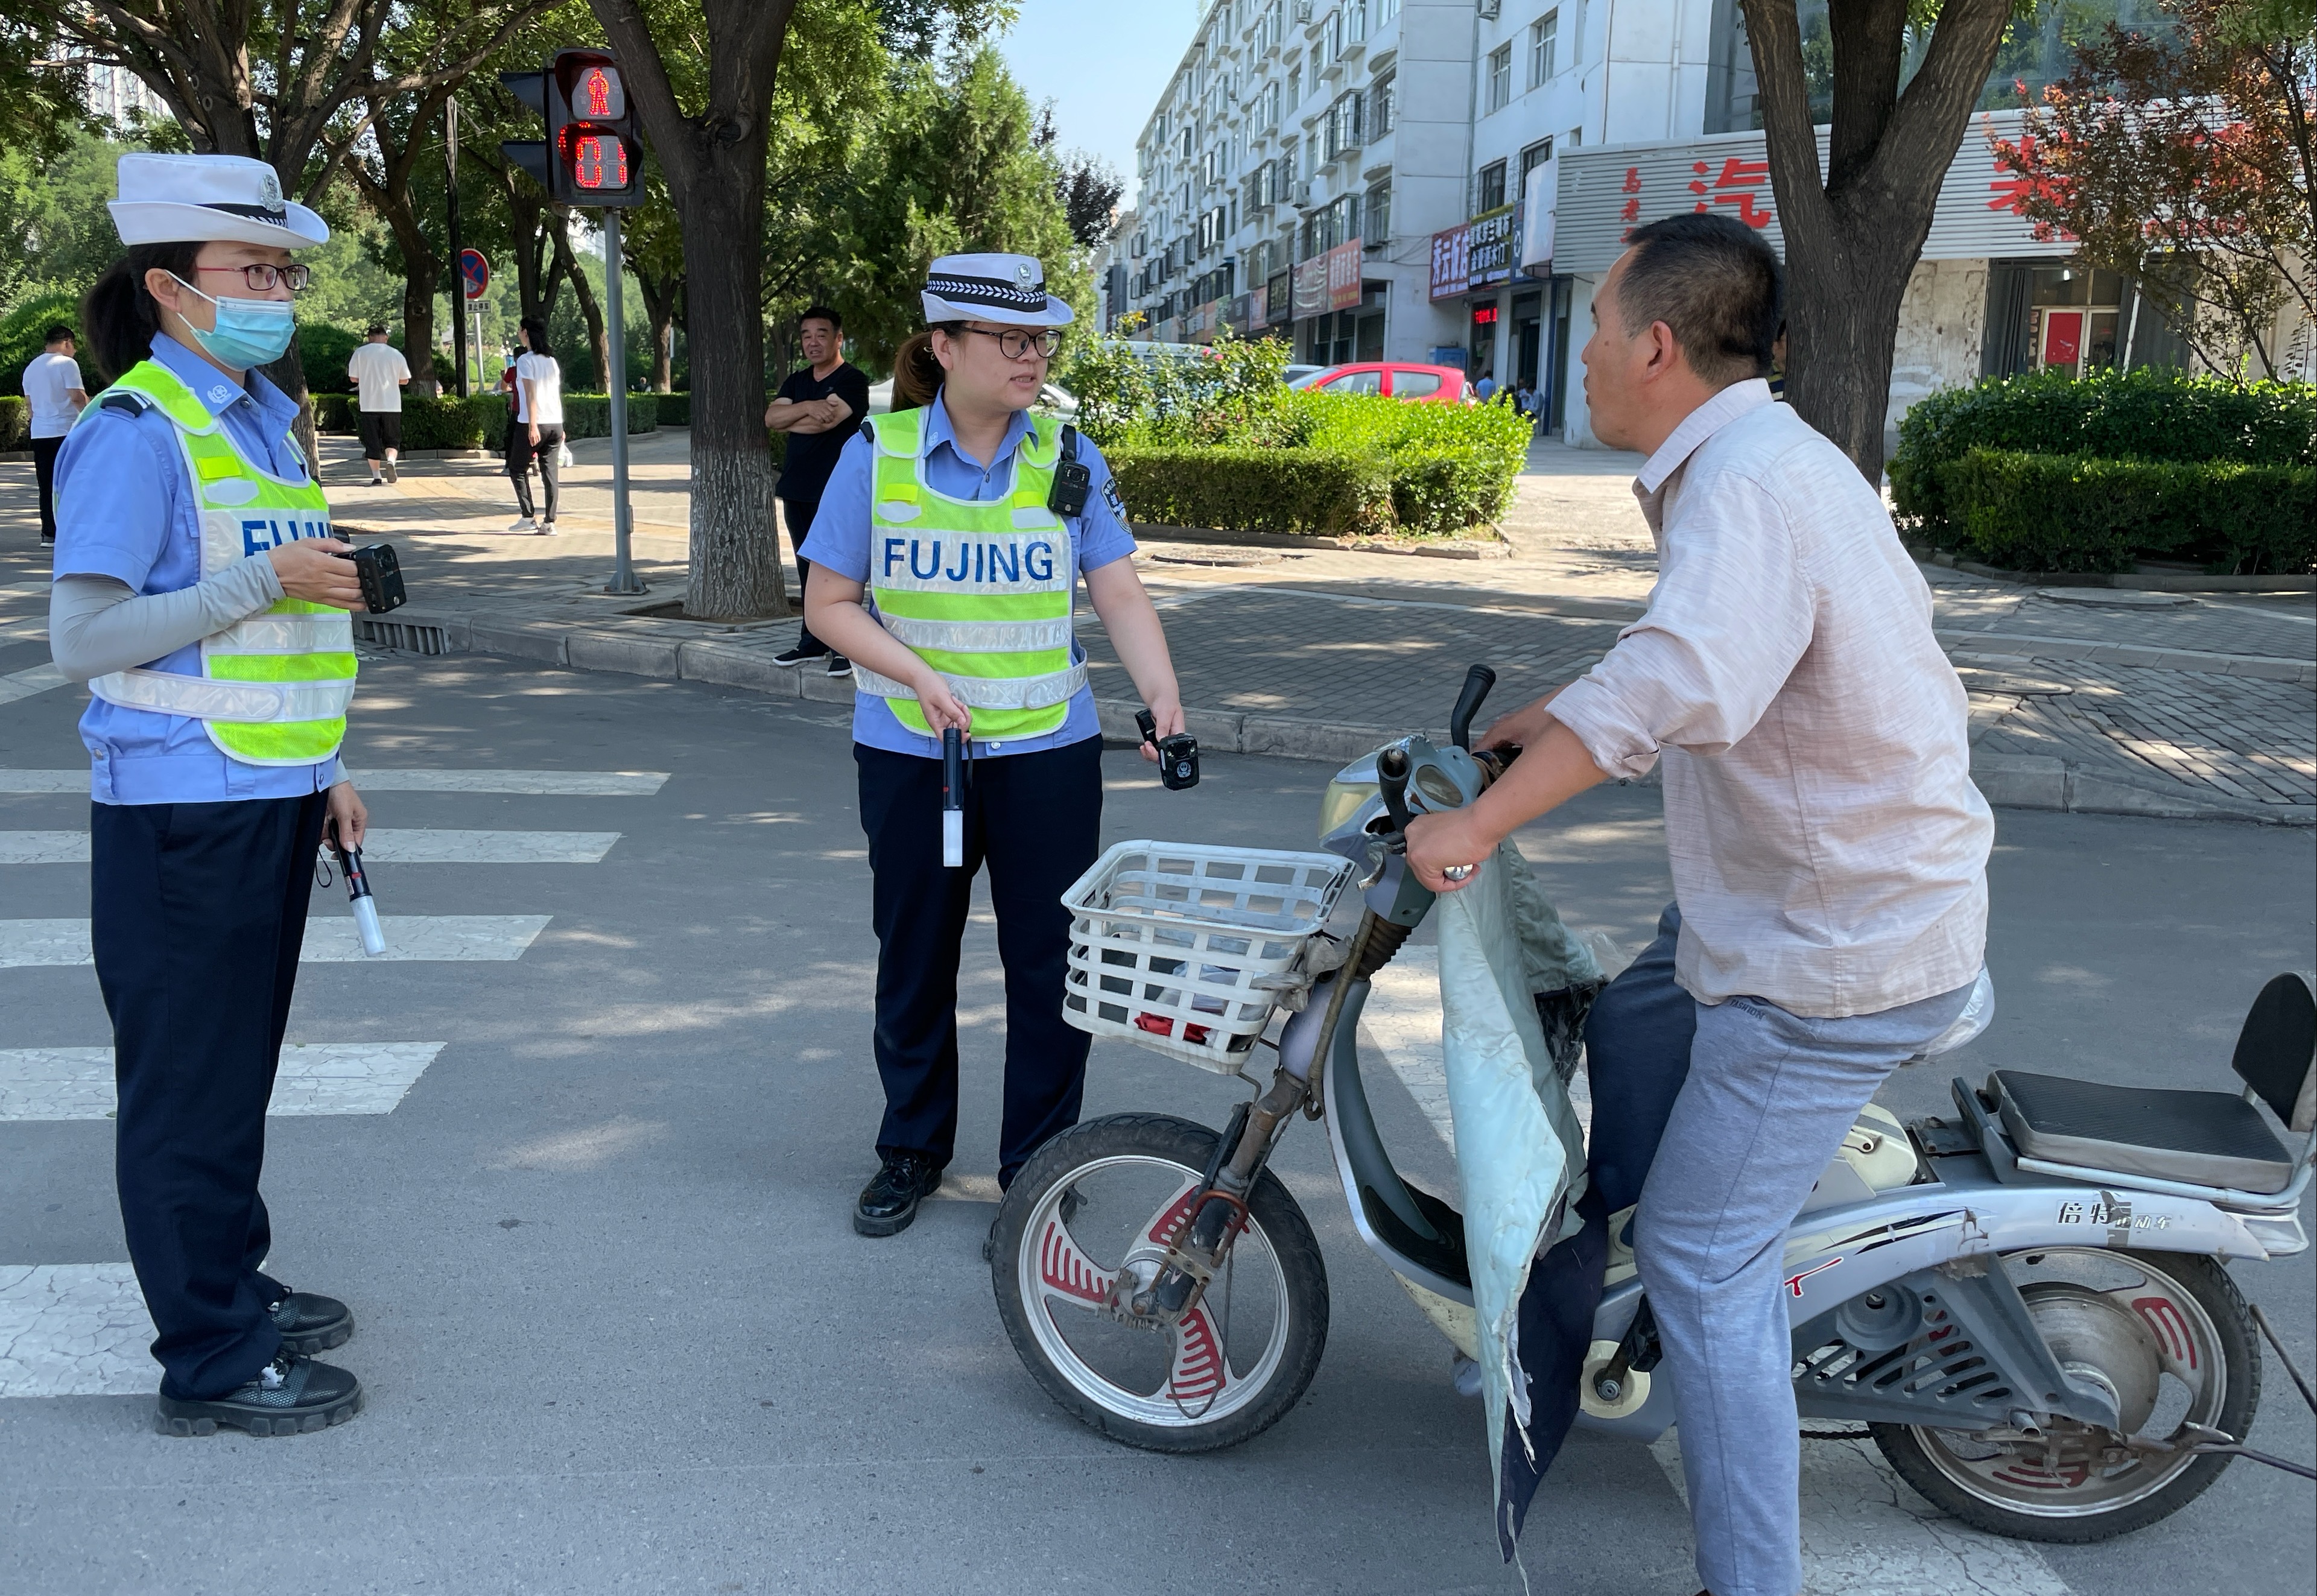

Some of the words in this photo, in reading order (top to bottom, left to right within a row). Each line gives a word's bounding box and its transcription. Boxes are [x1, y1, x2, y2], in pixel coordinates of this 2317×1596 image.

[575, 136, 627, 188] 01
[1620, 167, 1641, 244] 马老
[885, 539, 1053, 582] FUJING
